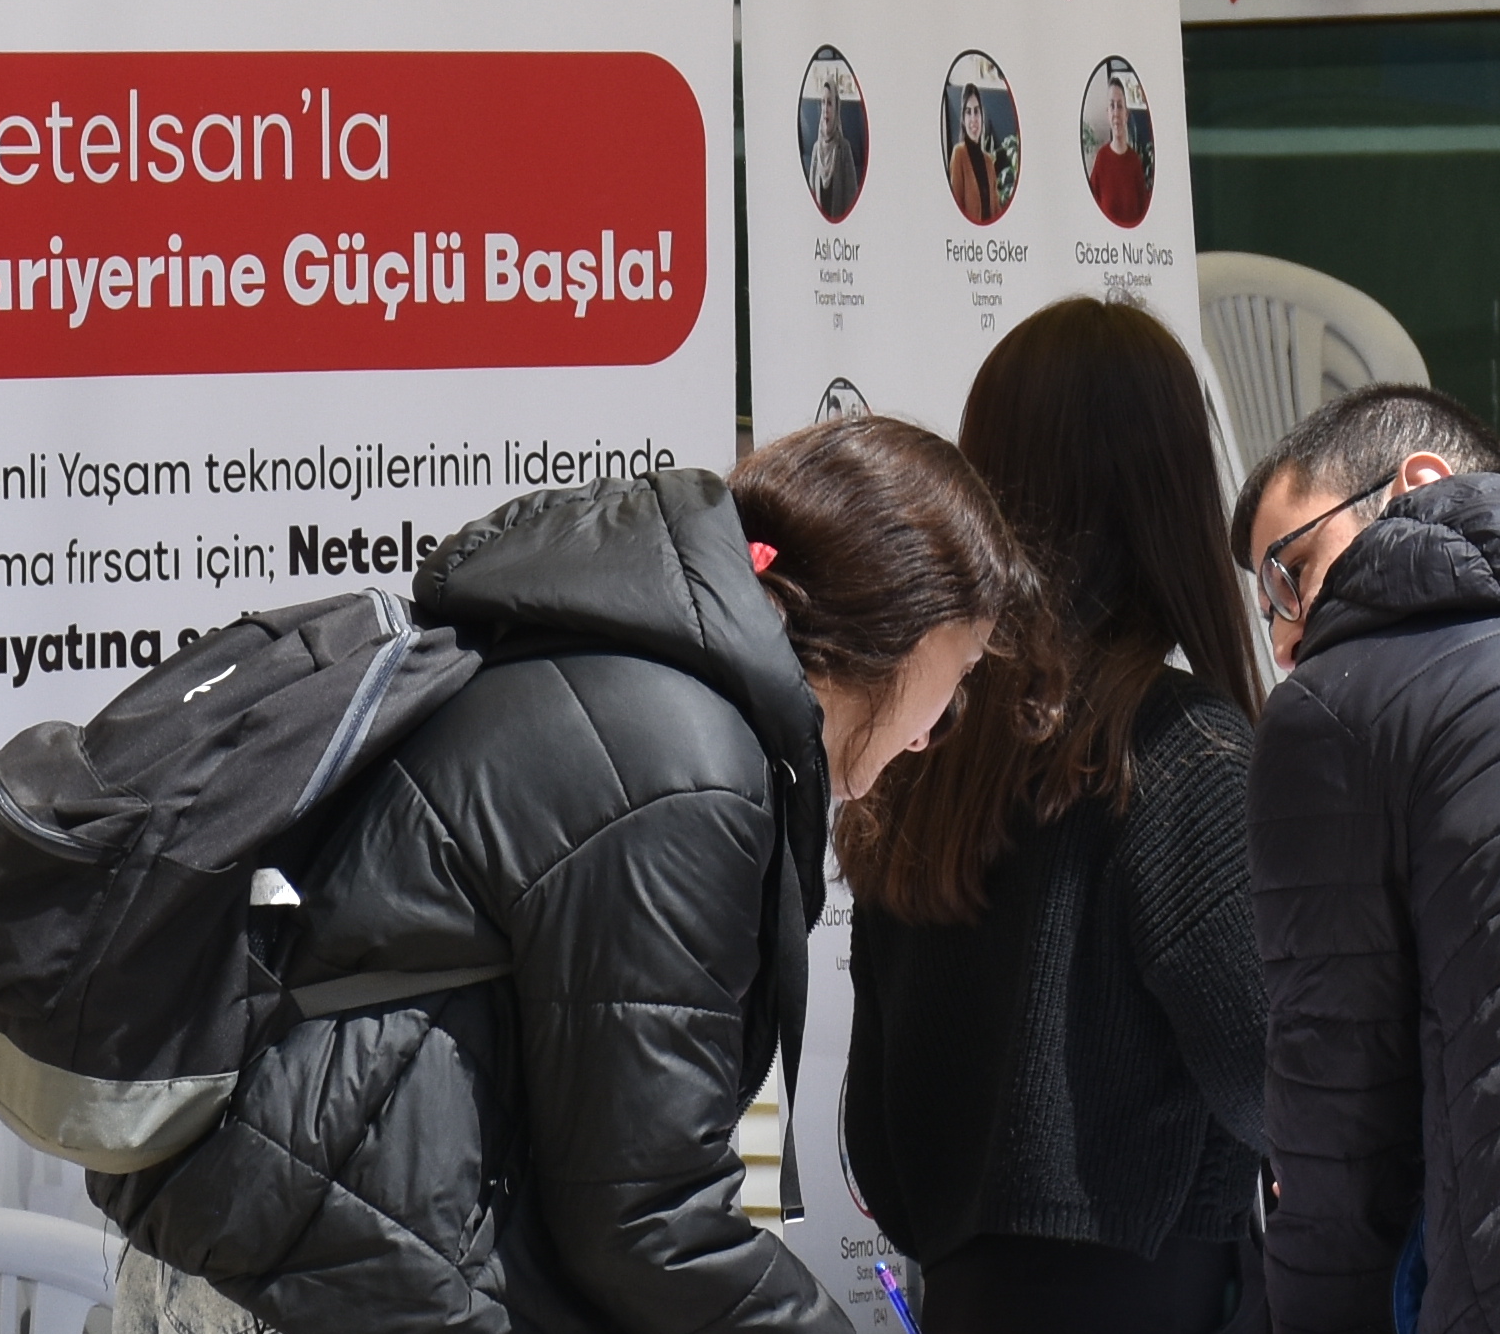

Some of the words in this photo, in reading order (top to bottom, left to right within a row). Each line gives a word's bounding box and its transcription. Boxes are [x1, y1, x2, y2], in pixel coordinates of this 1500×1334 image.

[945, 238, 984, 263] Feride
[986, 239, 1029, 263] Göker
[1075, 240, 1119, 265] Gözde
[1122, 242, 1144, 265] Nur
[1146, 242, 1174, 266] Sivas
[283, 231, 466, 321] Güçlü
[484, 229, 673, 318] Başla!
[966, 269, 983, 285] Veri
[983, 269, 1003, 287] Giriş
[1103, 271, 1127, 289] Satış
[1126, 271, 1153, 288] Destek
[971, 291, 1003, 307] Uzmanı
[980, 313, 996, 332] (27)
[57, 452, 191, 506] Yaşam
[204, 441, 492, 502] teknolojilerinin
[504, 437, 675, 487] liderinde
[65, 538, 180, 585] fırsatı
[196, 533, 275, 589] için;
[288, 520, 439, 577] Netels
[840, 1236, 874, 1260] Sema
